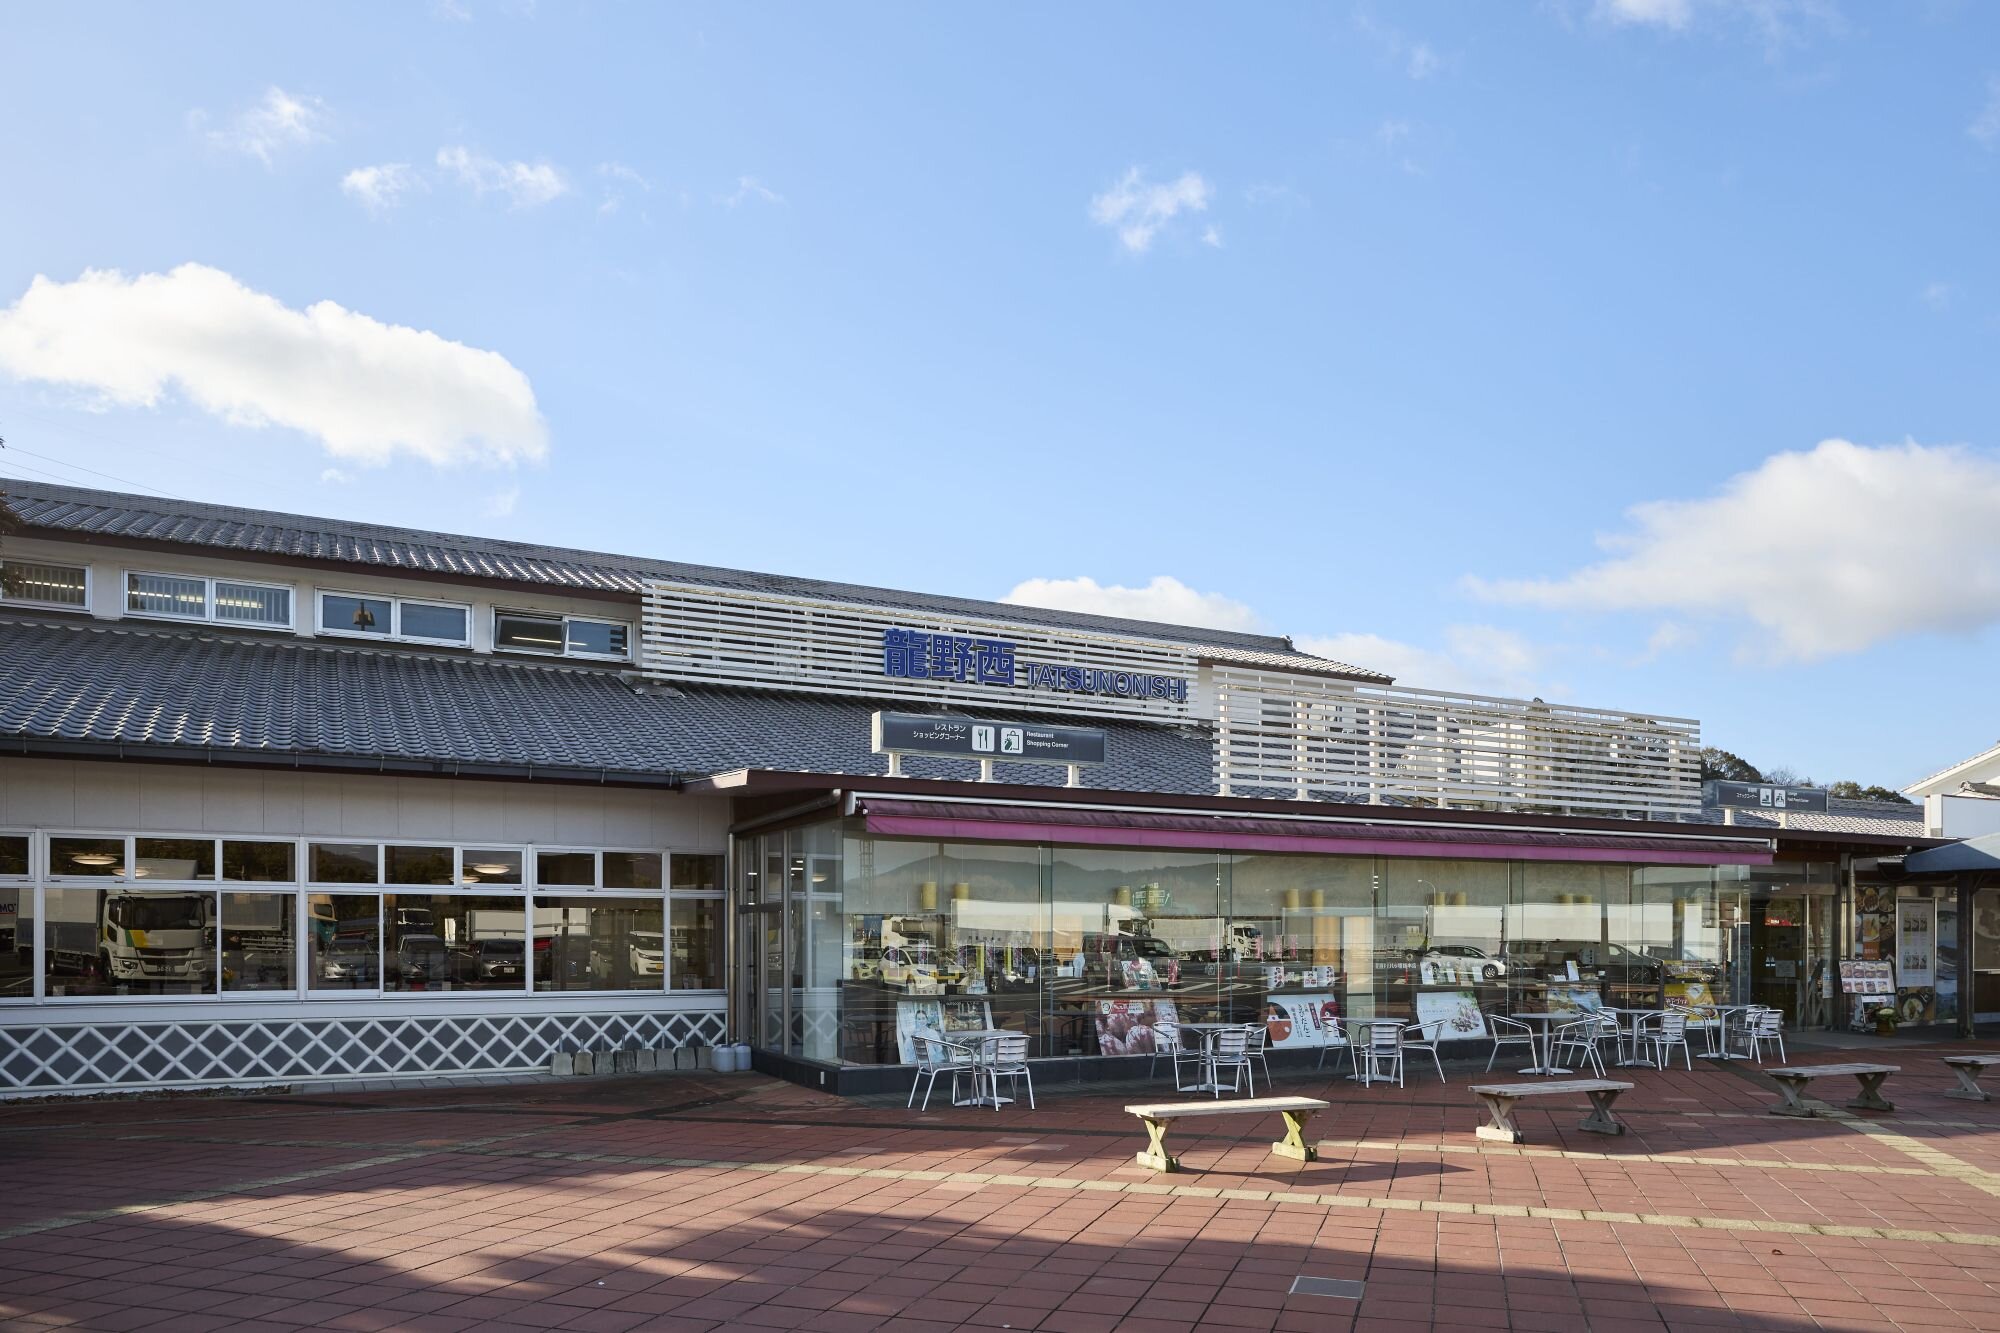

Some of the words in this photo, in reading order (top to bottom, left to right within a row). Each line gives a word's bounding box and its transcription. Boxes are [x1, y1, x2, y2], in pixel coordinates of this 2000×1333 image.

[883, 628, 1016, 686] 龍野西
[1024, 663, 1187, 699] TATSUNONISHI
[935, 723, 966, 732] レストラン
[913, 731, 966, 741] ショッピングコーナー
[1026, 731, 1054, 739] Restaurant
[1026, 739, 1050, 748] Shopping
